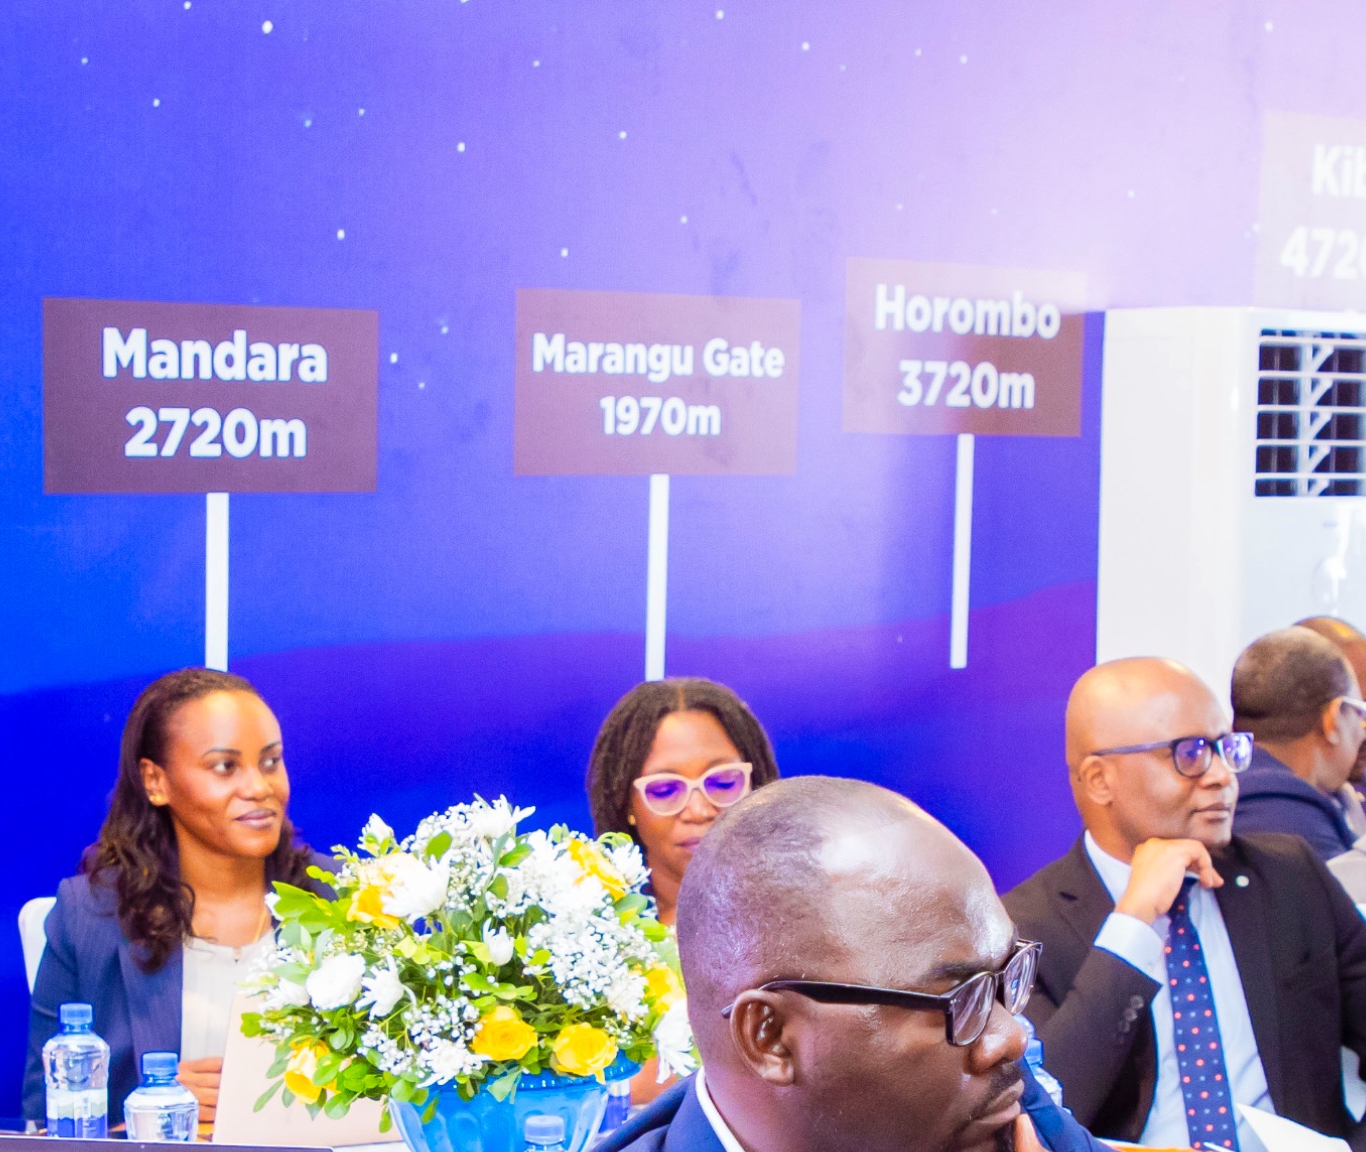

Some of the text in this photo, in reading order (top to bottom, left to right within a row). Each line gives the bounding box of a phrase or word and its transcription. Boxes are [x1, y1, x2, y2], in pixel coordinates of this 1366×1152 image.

[874, 282, 1062, 341] Horombo
[102, 326, 328, 383] Mandara
[532, 332, 786, 384] Marangu Gate
[897, 358, 1035, 409] 3720m
[124, 405, 307, 458] 2720m
[600, 395, 721, 437] 1970m
